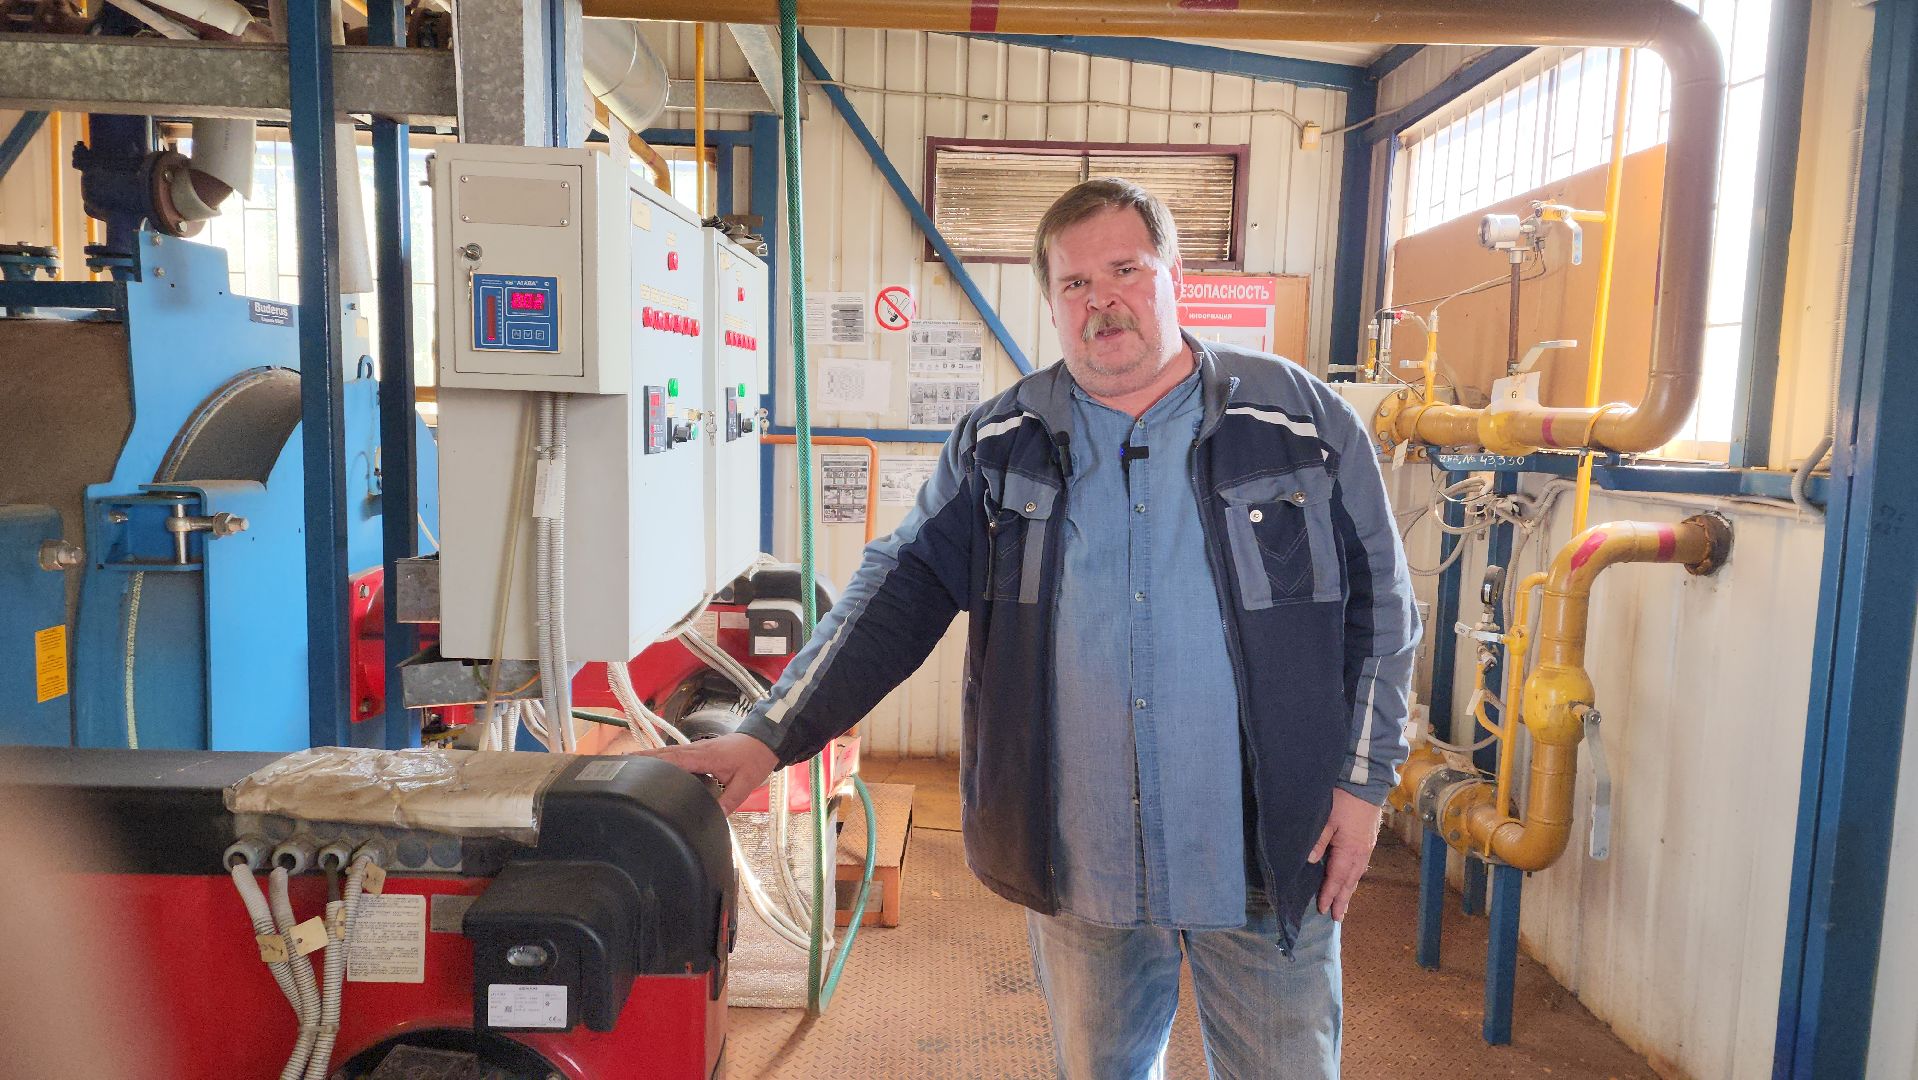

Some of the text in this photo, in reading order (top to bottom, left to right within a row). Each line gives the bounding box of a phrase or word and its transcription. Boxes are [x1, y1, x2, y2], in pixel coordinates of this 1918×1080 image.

[1181, 283, 1270, 300] ЕЗОПАСНОСТЬ
[254, 301, 289, 317] Buderus
[1511, 390, 1518, 399] 6
